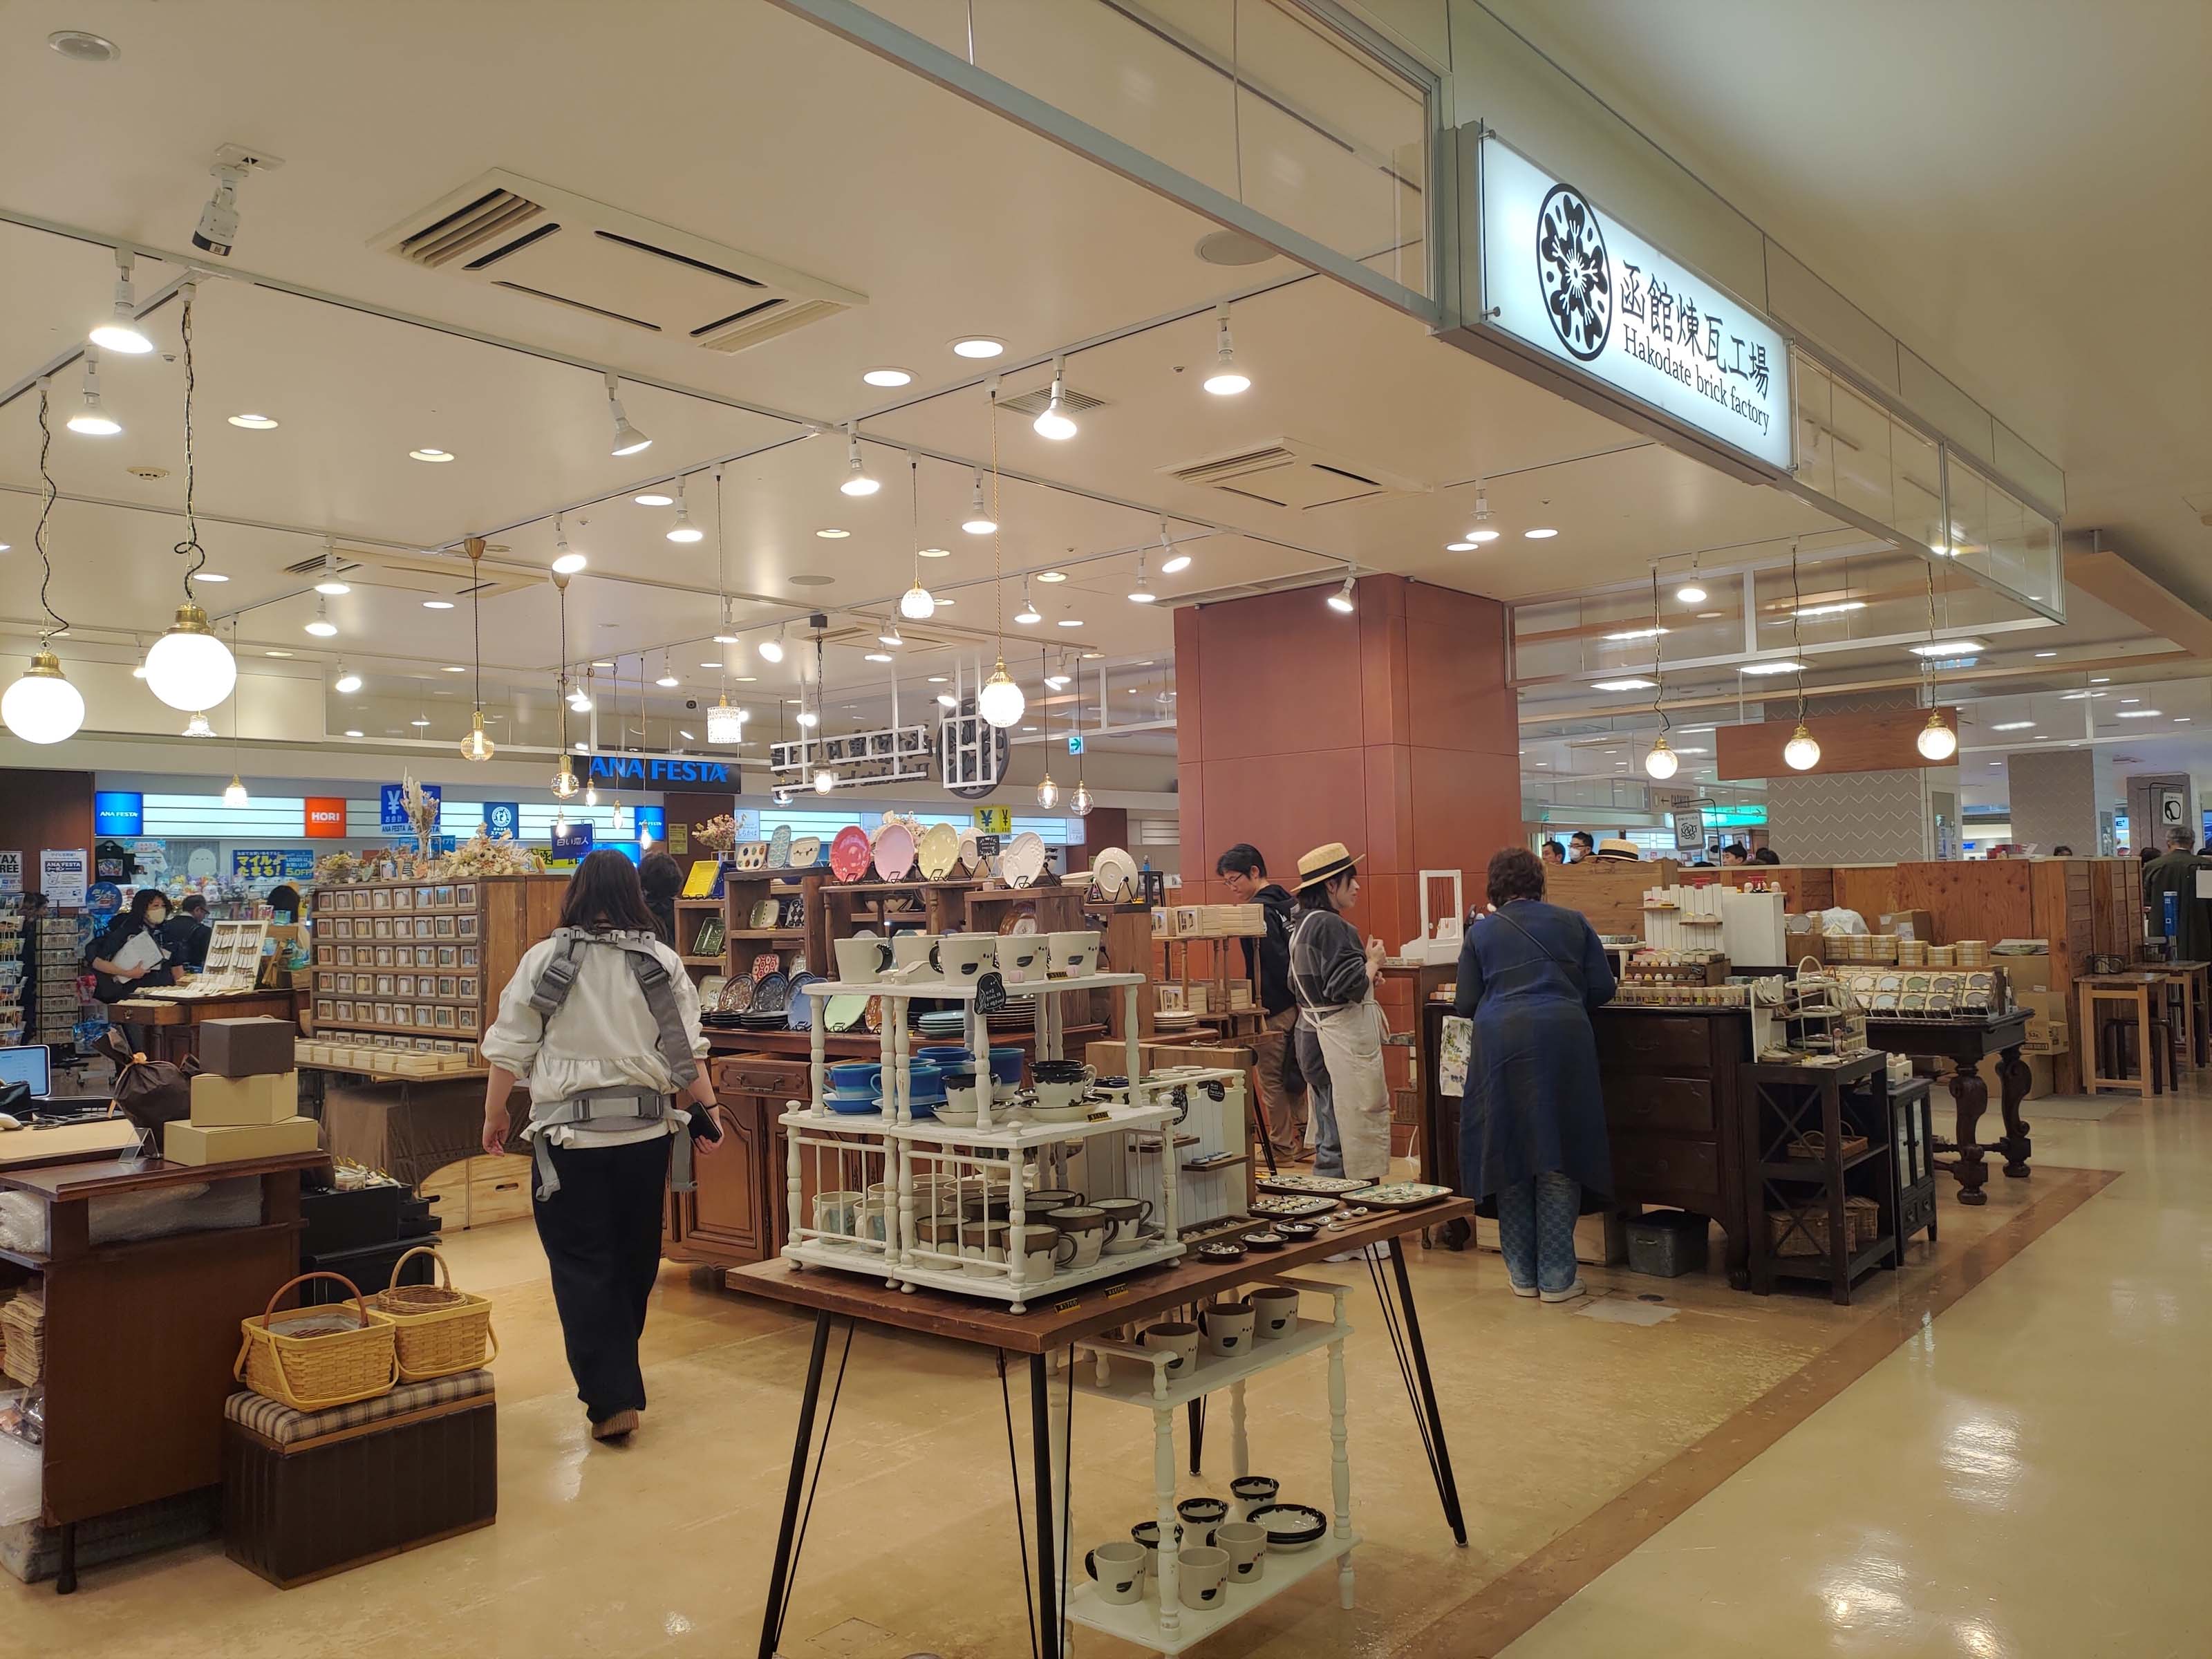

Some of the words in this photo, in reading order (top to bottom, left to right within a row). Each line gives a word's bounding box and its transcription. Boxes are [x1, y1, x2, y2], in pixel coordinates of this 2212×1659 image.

[1620, 260, 1770, 401] 函館煉瓦工場
[1624, 324, 1692, 386] Hakodate
[1696, 364, 1728, 407] brick
[1730, 386, 1770, 436] factory
[591, 757, 645, 778] ANA
[651, 760, 729, 782] FESTA
[311, 812, 339, 821] HORI
[556, 836, 588, 846] 白い恋人
[0, 854, 17, 863] AX
[0, 864, 19, 873] REE
